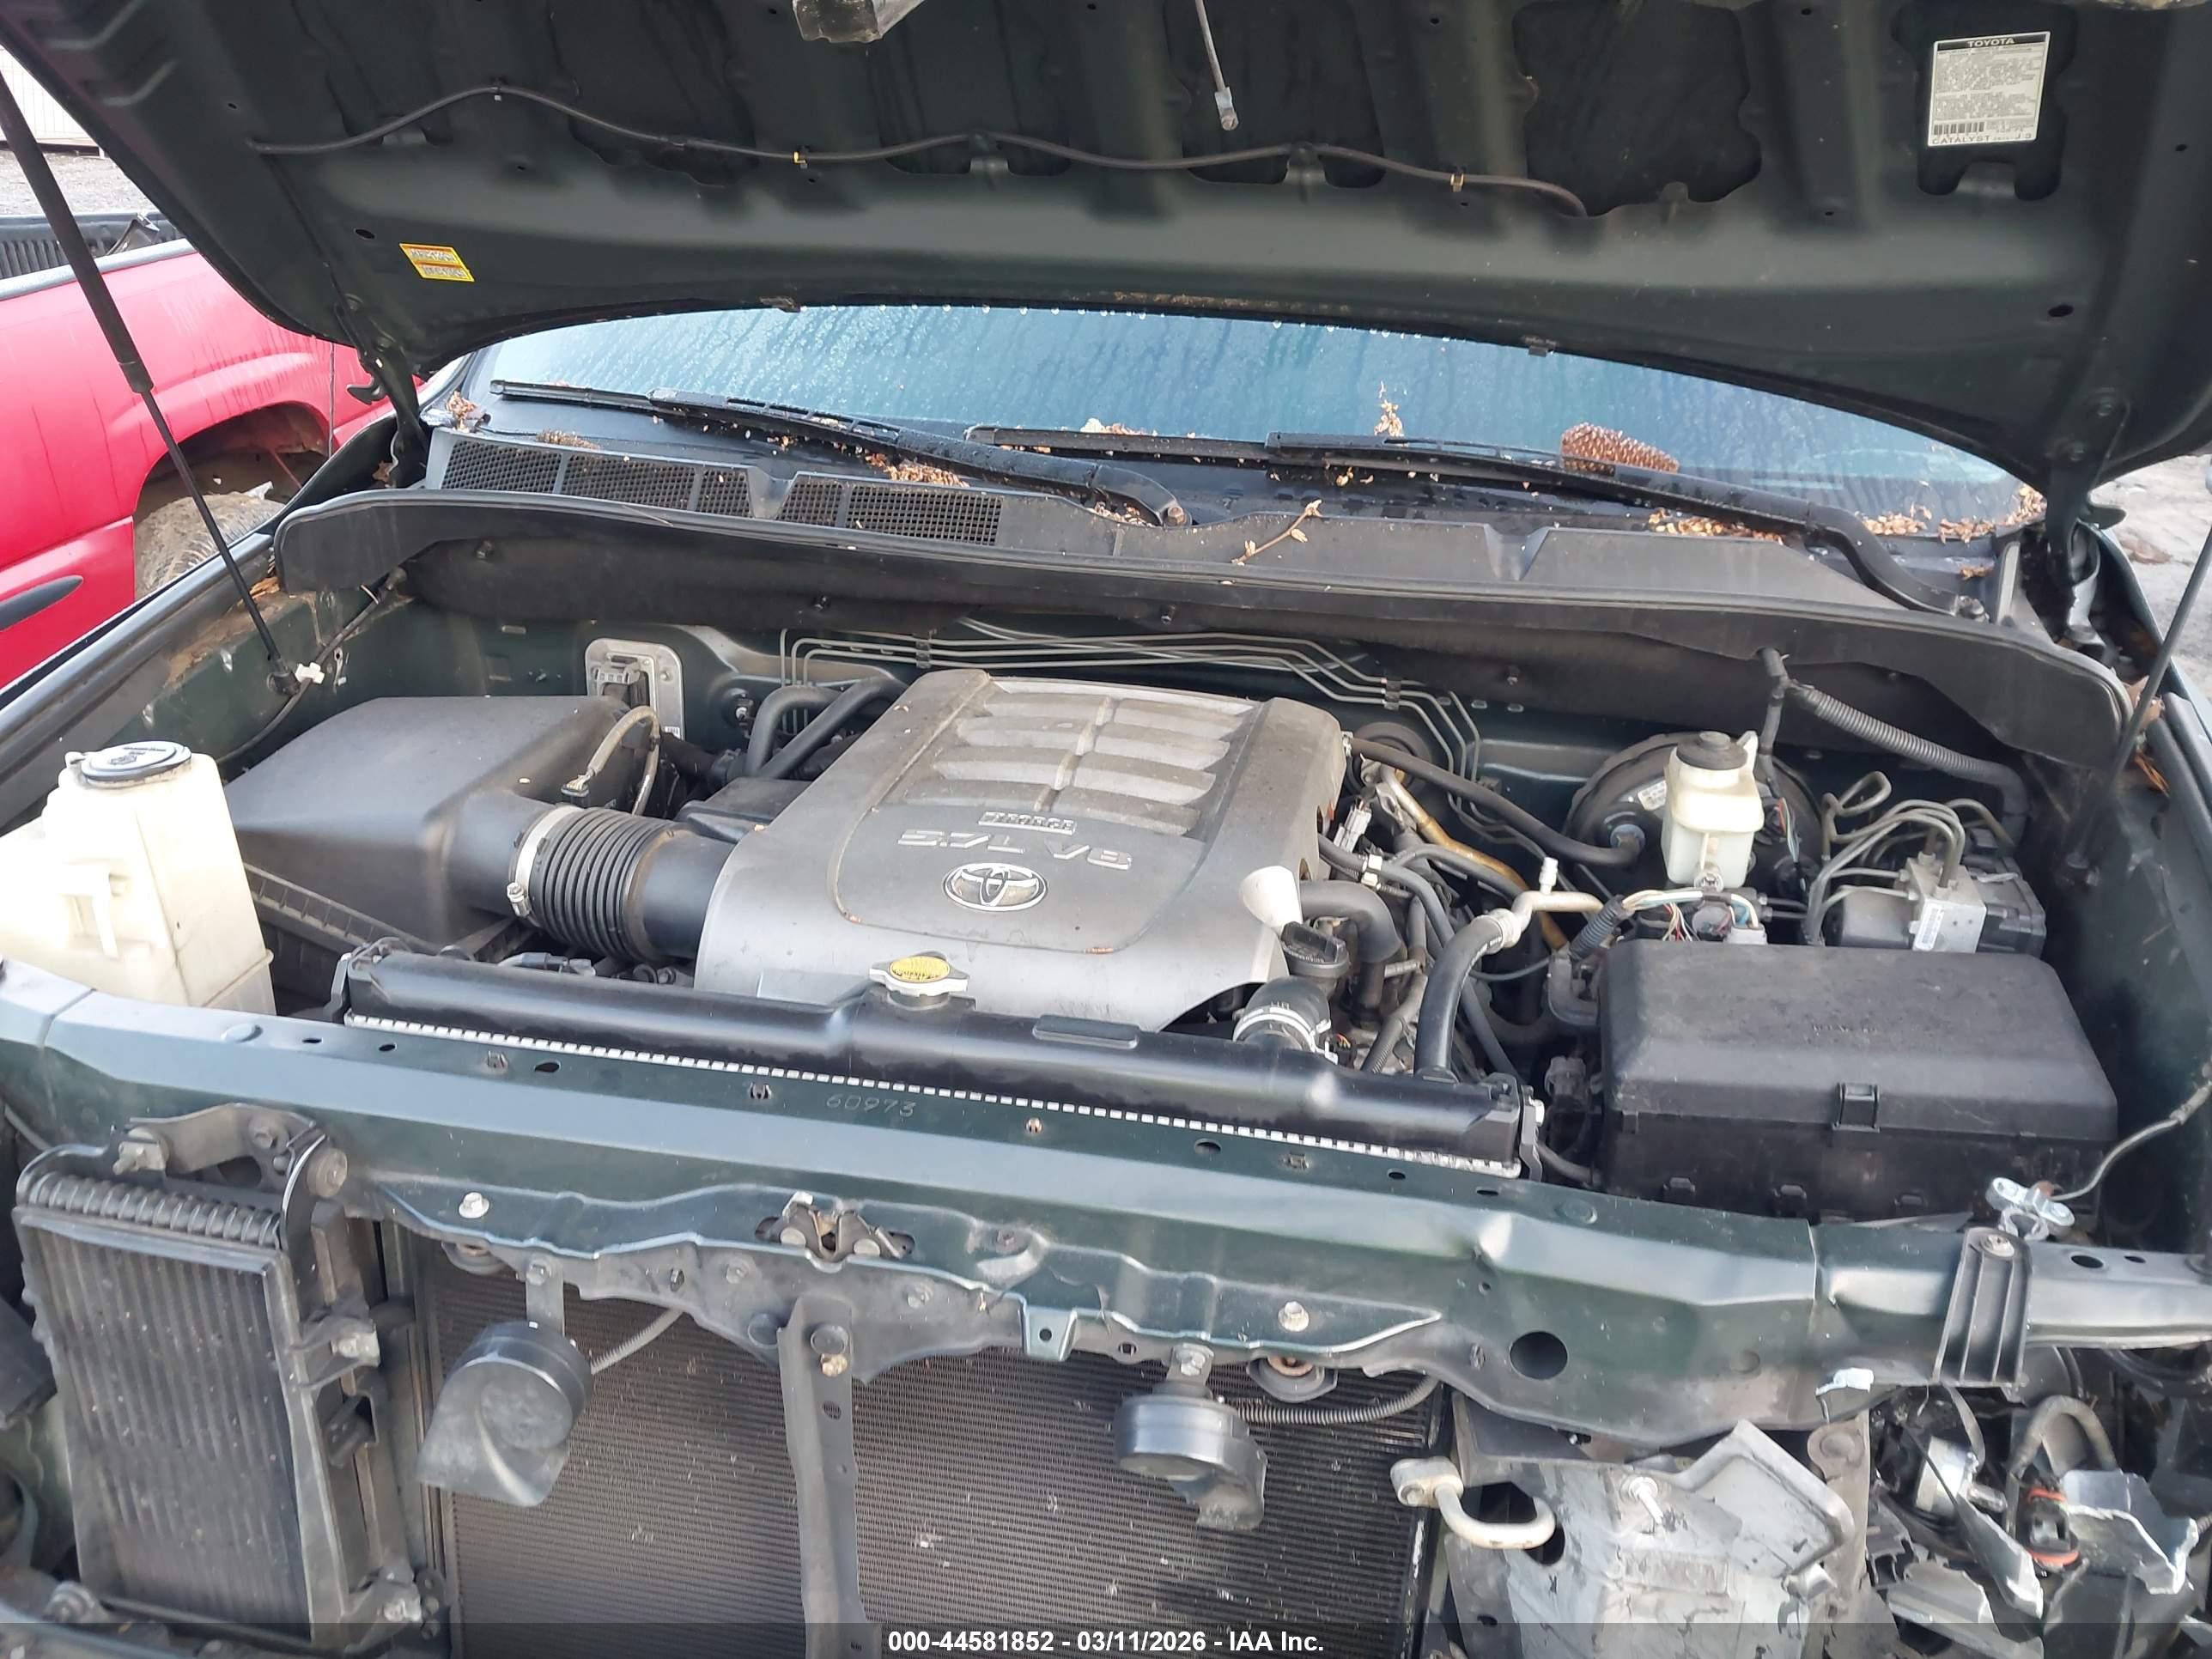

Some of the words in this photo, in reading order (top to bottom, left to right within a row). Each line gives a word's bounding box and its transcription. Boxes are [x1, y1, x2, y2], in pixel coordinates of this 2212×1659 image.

[1967, 37, 2015, 48] TOYOTA
[1931, 135, 1990, 145] CATALYST
[897, 829, 1025, 854] 5.7L
[1044, 836, 1133, 870] V8
[826, 1093, 916, 1118] 60973
